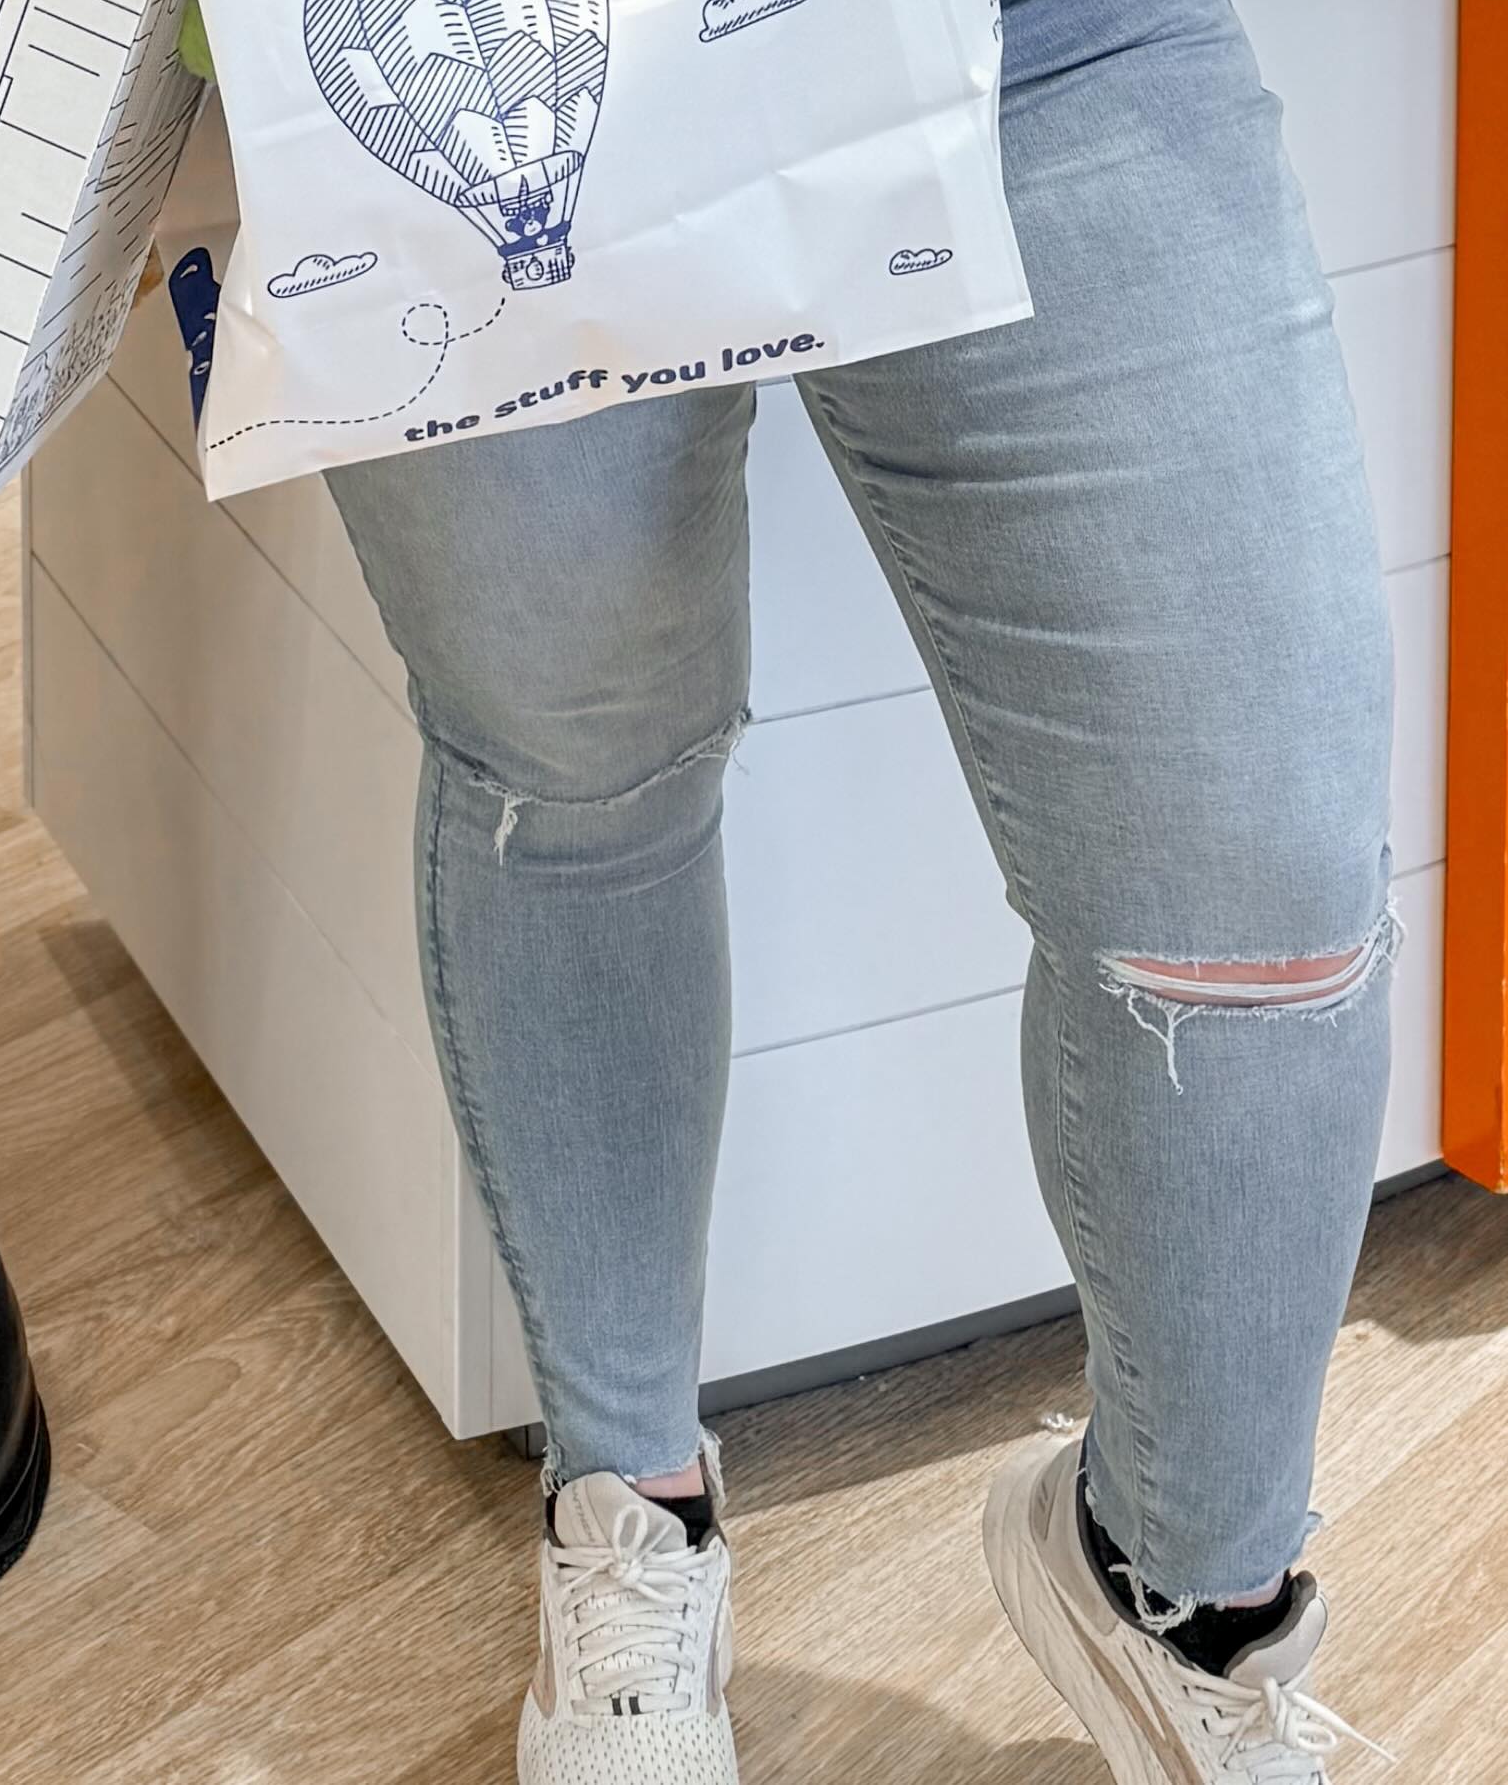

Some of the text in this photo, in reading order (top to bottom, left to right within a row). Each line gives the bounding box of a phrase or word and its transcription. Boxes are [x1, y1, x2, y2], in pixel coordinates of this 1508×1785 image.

[404, 333, 826, 443] the stuff you love.
